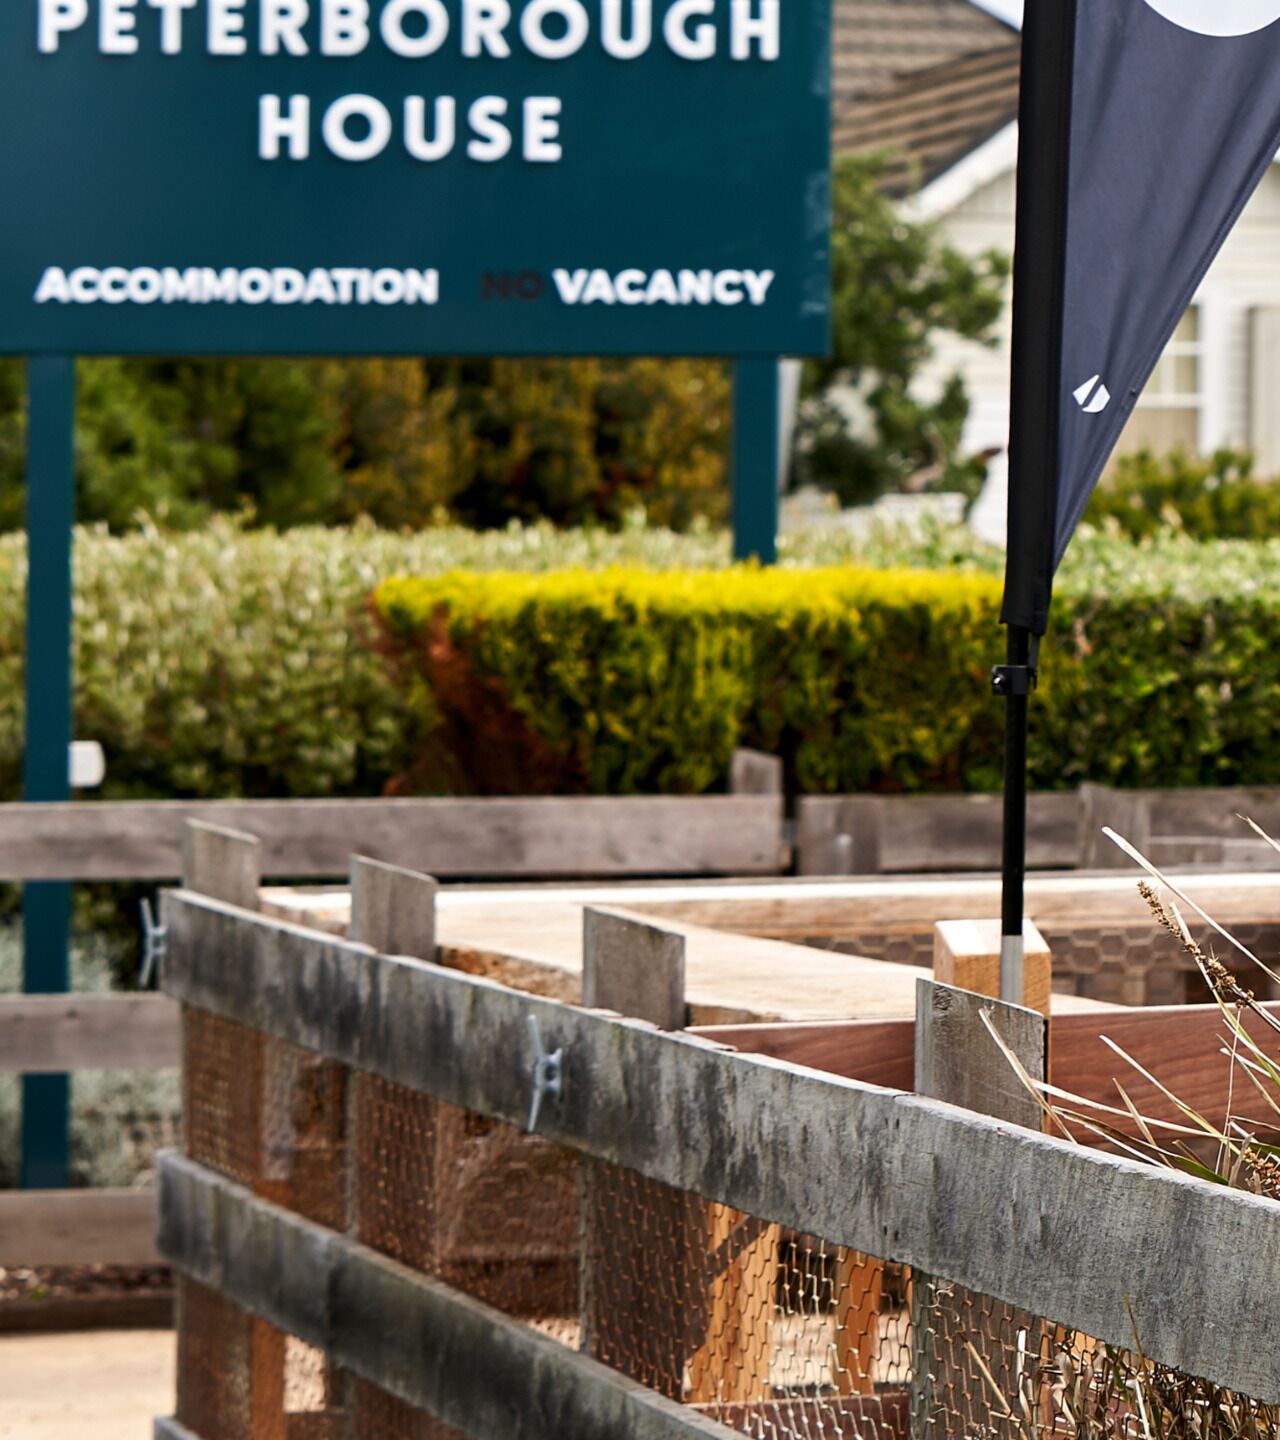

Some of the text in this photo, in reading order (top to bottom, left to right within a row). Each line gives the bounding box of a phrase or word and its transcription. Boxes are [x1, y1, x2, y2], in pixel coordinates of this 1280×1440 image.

[258, 92, 563, 162] HOUSE
[35, 266, 775, 305] ACCOMMODATION NO VACANCY
